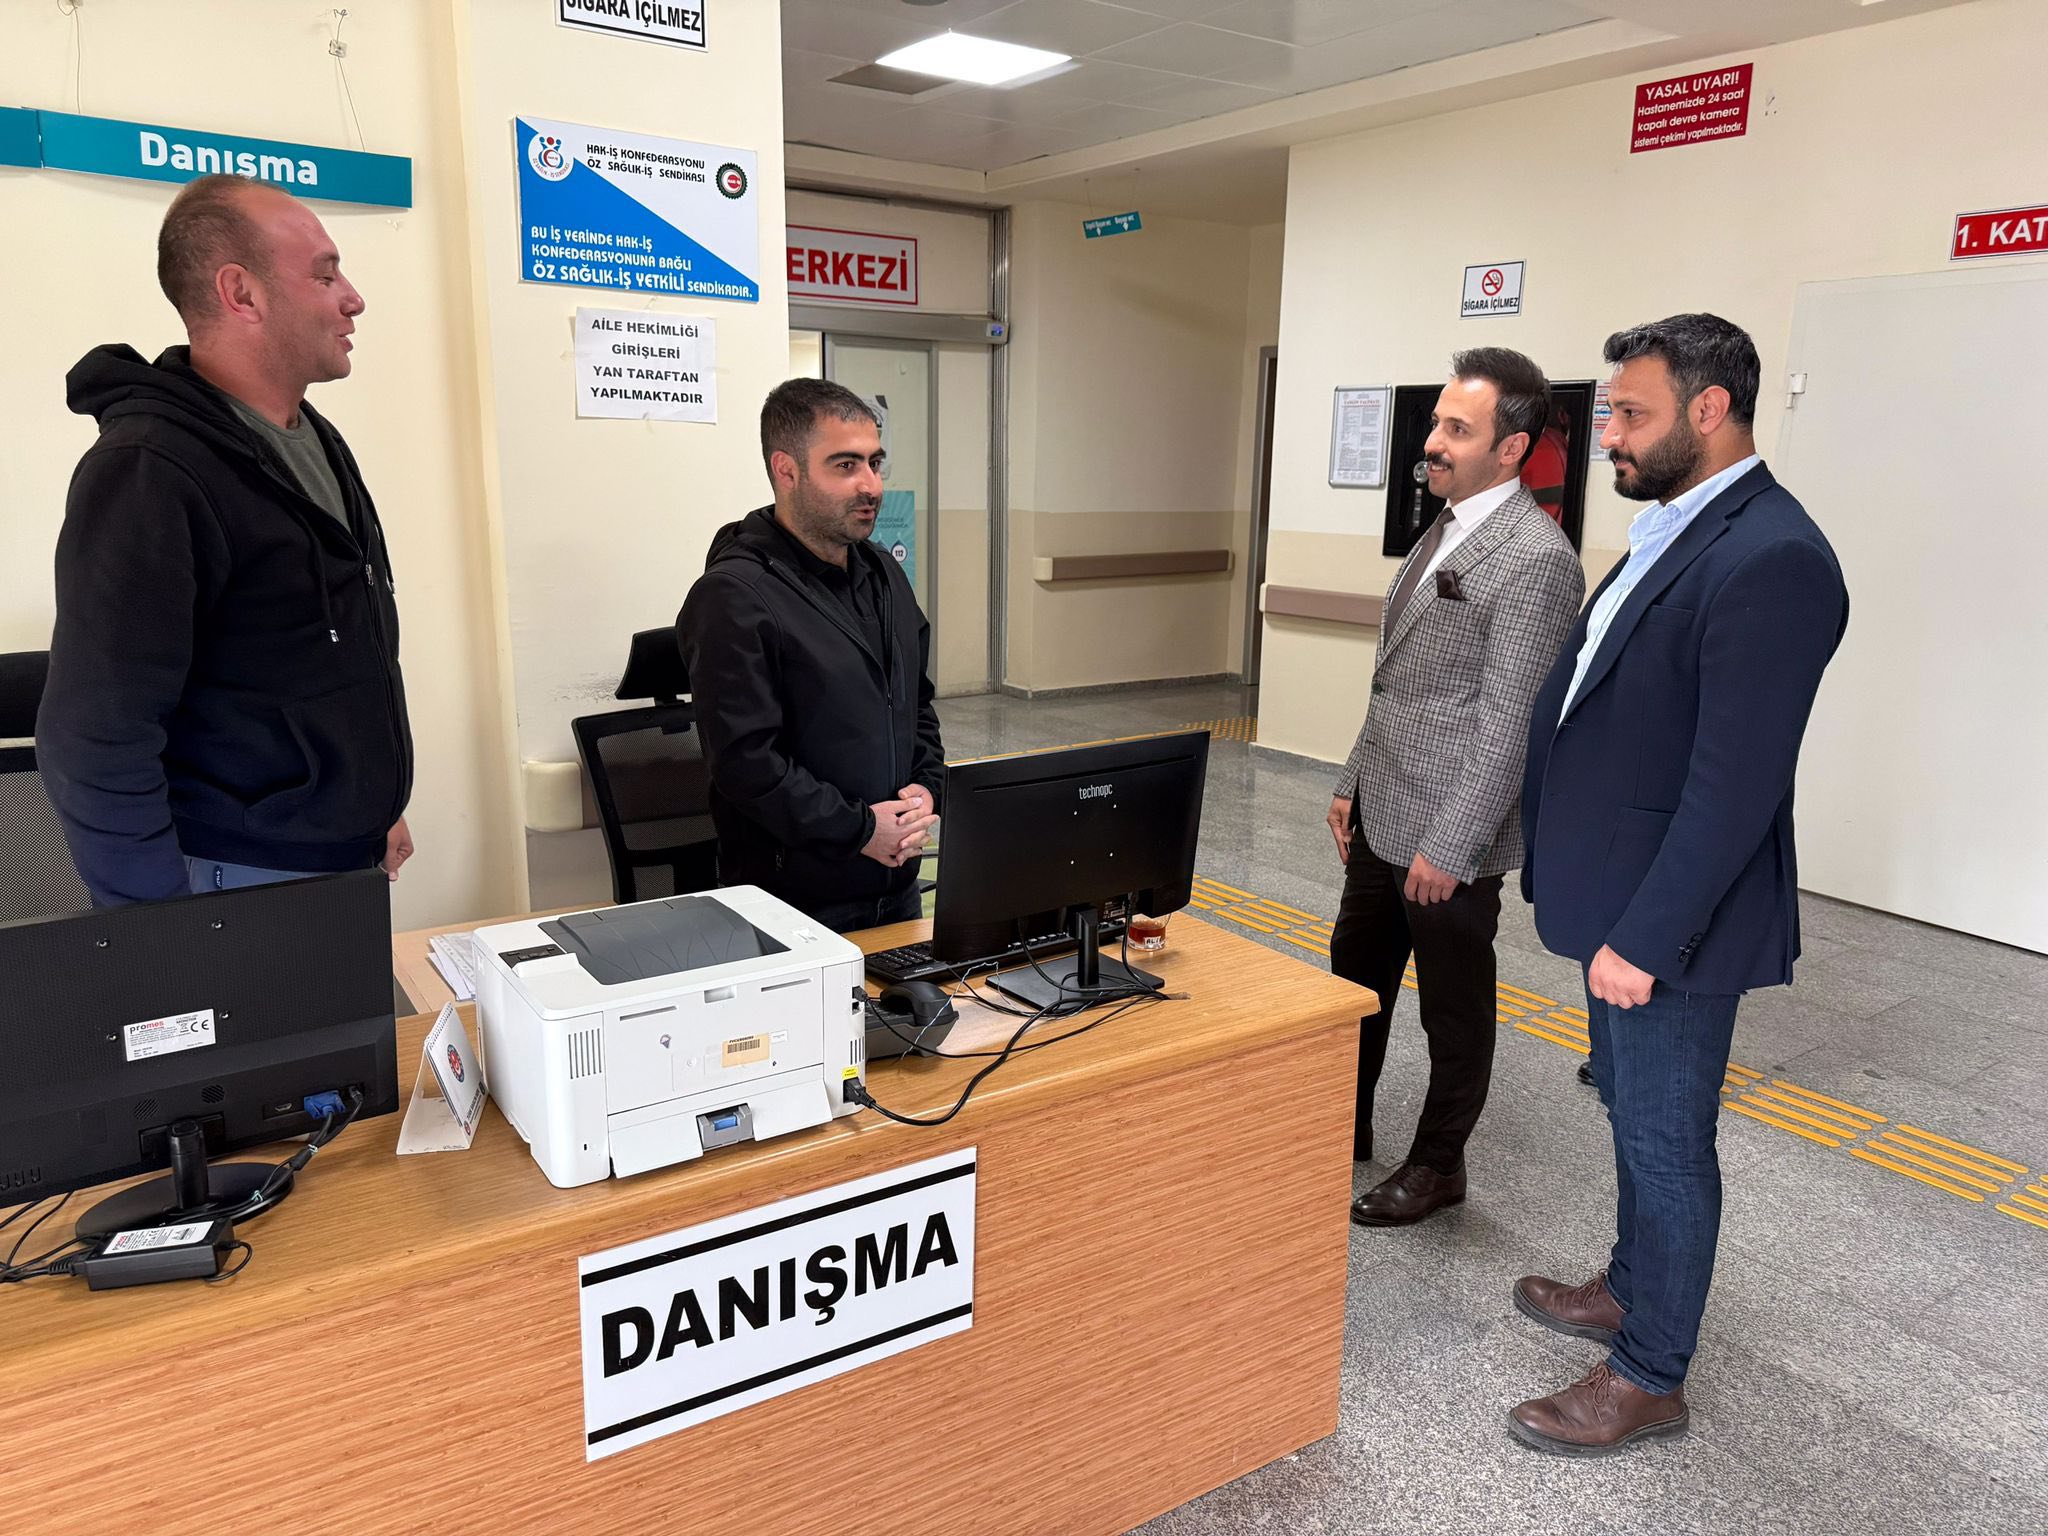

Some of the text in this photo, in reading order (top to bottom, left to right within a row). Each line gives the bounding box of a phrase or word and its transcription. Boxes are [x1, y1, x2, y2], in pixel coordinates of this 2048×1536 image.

[1646, 71, 1740, 100] YASAL UYARI!
[1637, 88, 1745, 117] Hastanemizde 24 saat
[1637, 106, 1740, 133] kapalı devre kamera
[1634, 122, 1743, 148] sistemi çekimi yapılmaktadır.
[587, 143, 705, 169] HAK-İŞ KONFEDERASYONU
[587, 155, 602, 169] ÖZ
[608, 160, 653, 178] SAĞLIK-İŞ
[659, 168, 705, 183] SENDİKASI
[531, 225, 653, 252] BU İŞ YERİNDE HAK-İŞ
[1957, 216, 2048, 249] 1. KAT
[531, 244, 692, 271] KONFEDERASYONUNA BAĞLI
[533, 260, 753, 298] ÖZ SAĞLIK-İŞ YETKİLİ SENDİKADIR.
[1463, 296, 1519, 311] SİGARA İÇİLMEZ
[592, 317, 699, 338] AİLE HEKİMLİĞİ
[611, 342, 681, 359] GİRİŞLERİ
[593, 365, 699, 383] YAN TARAFTAN
[590, 387, 703, 404] YAPILMAKTADIR
[1079, 783, 1113, 800] technopc
[129, 1020, 165, 1035] promes
[601, 1211, 959, 1379] DANIŞMA
